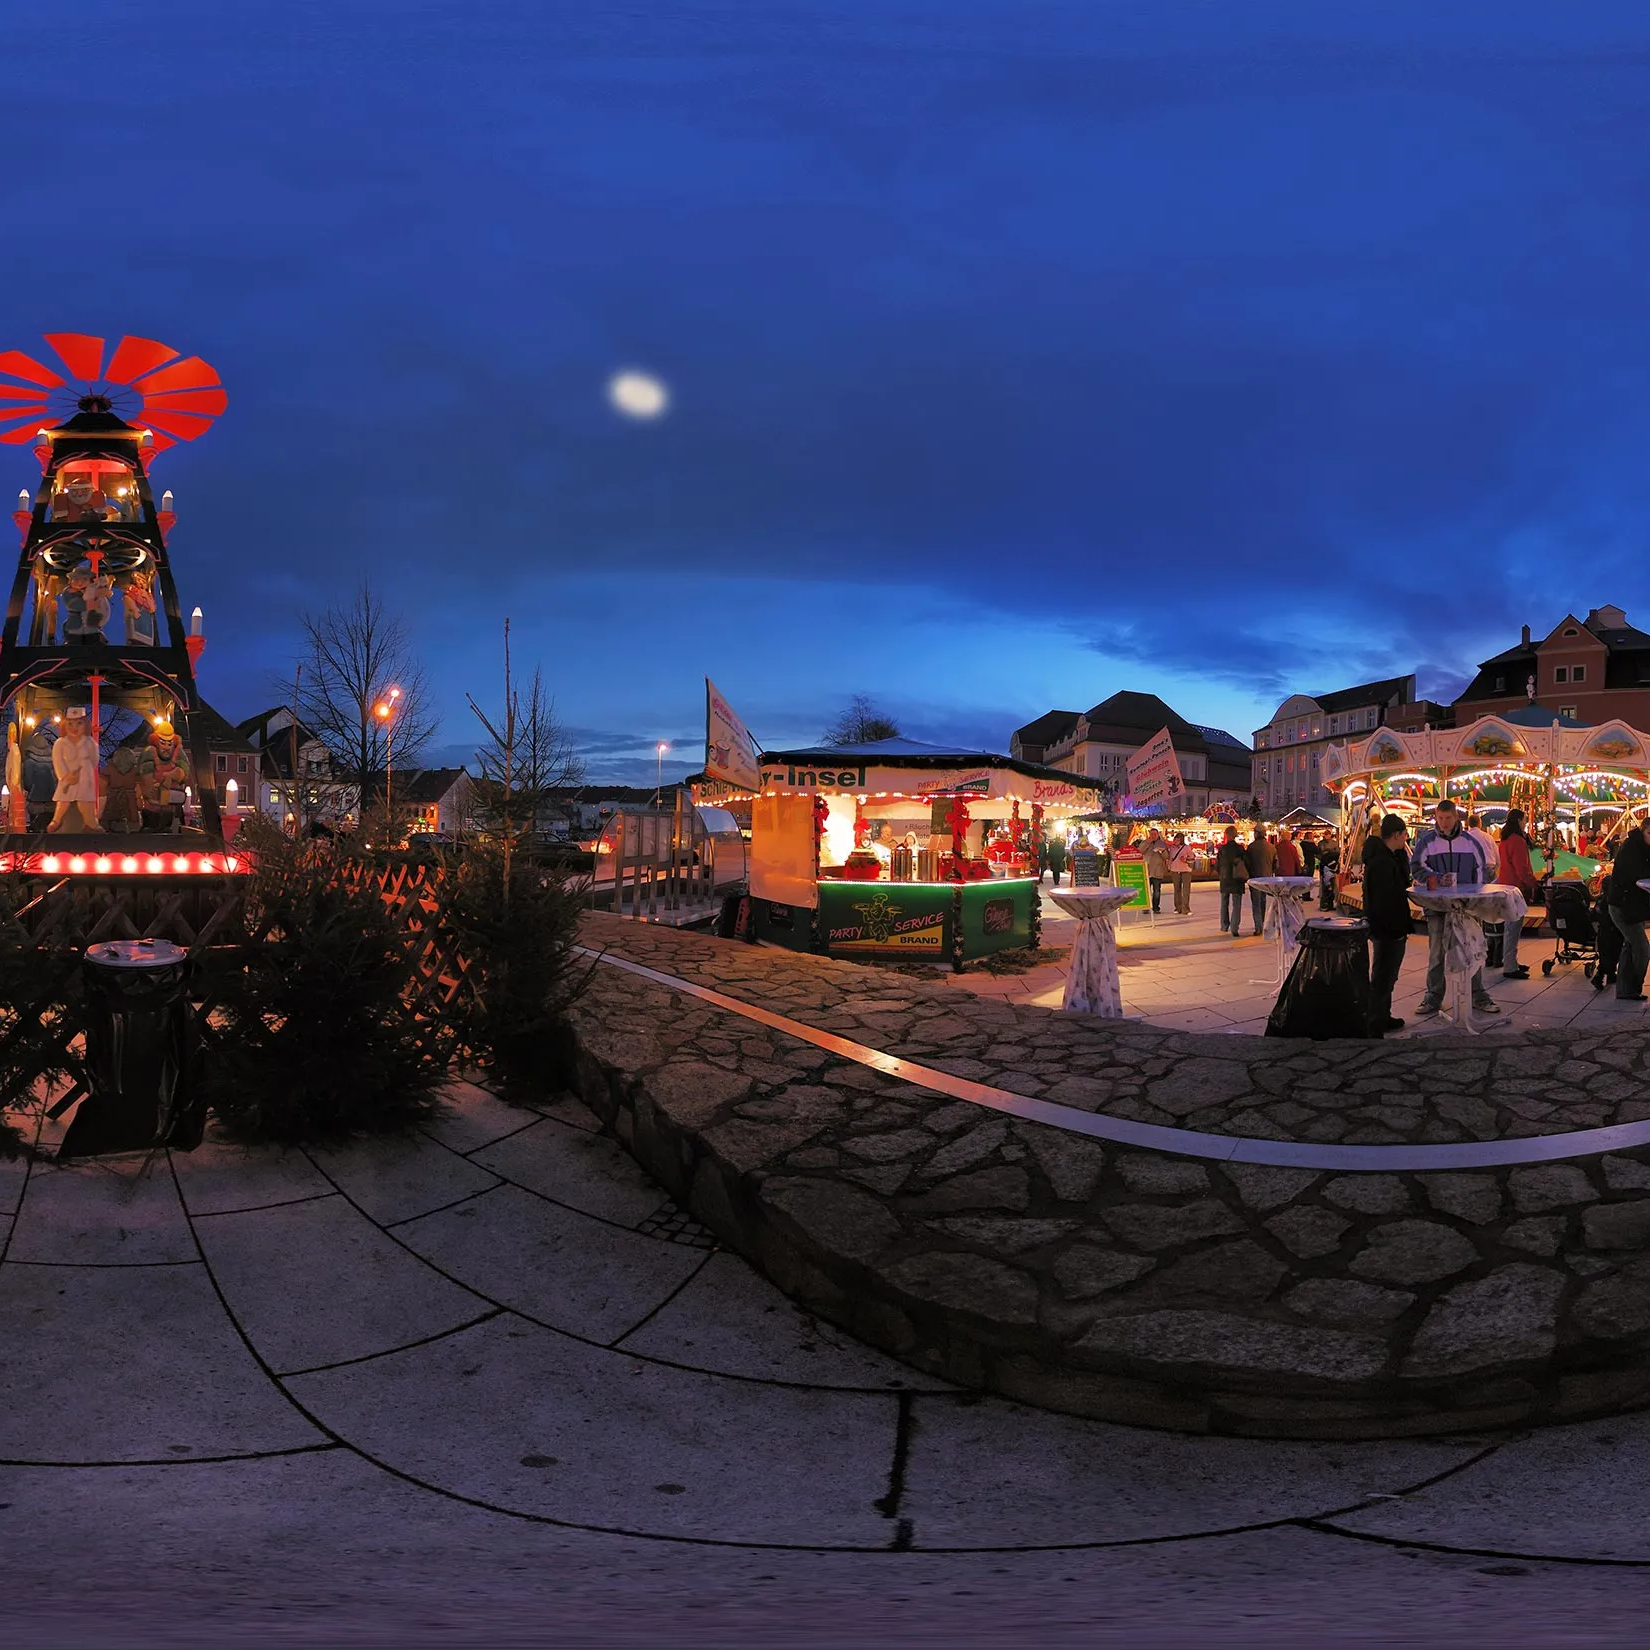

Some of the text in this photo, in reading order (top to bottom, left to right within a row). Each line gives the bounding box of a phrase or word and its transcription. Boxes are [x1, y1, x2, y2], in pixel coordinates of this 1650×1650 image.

[917, 770, 990, 789] PARTY SERVICE
[829, 911, 945, 940] PARTY SERVICE
[899, 936, 939, 945] BRAND
